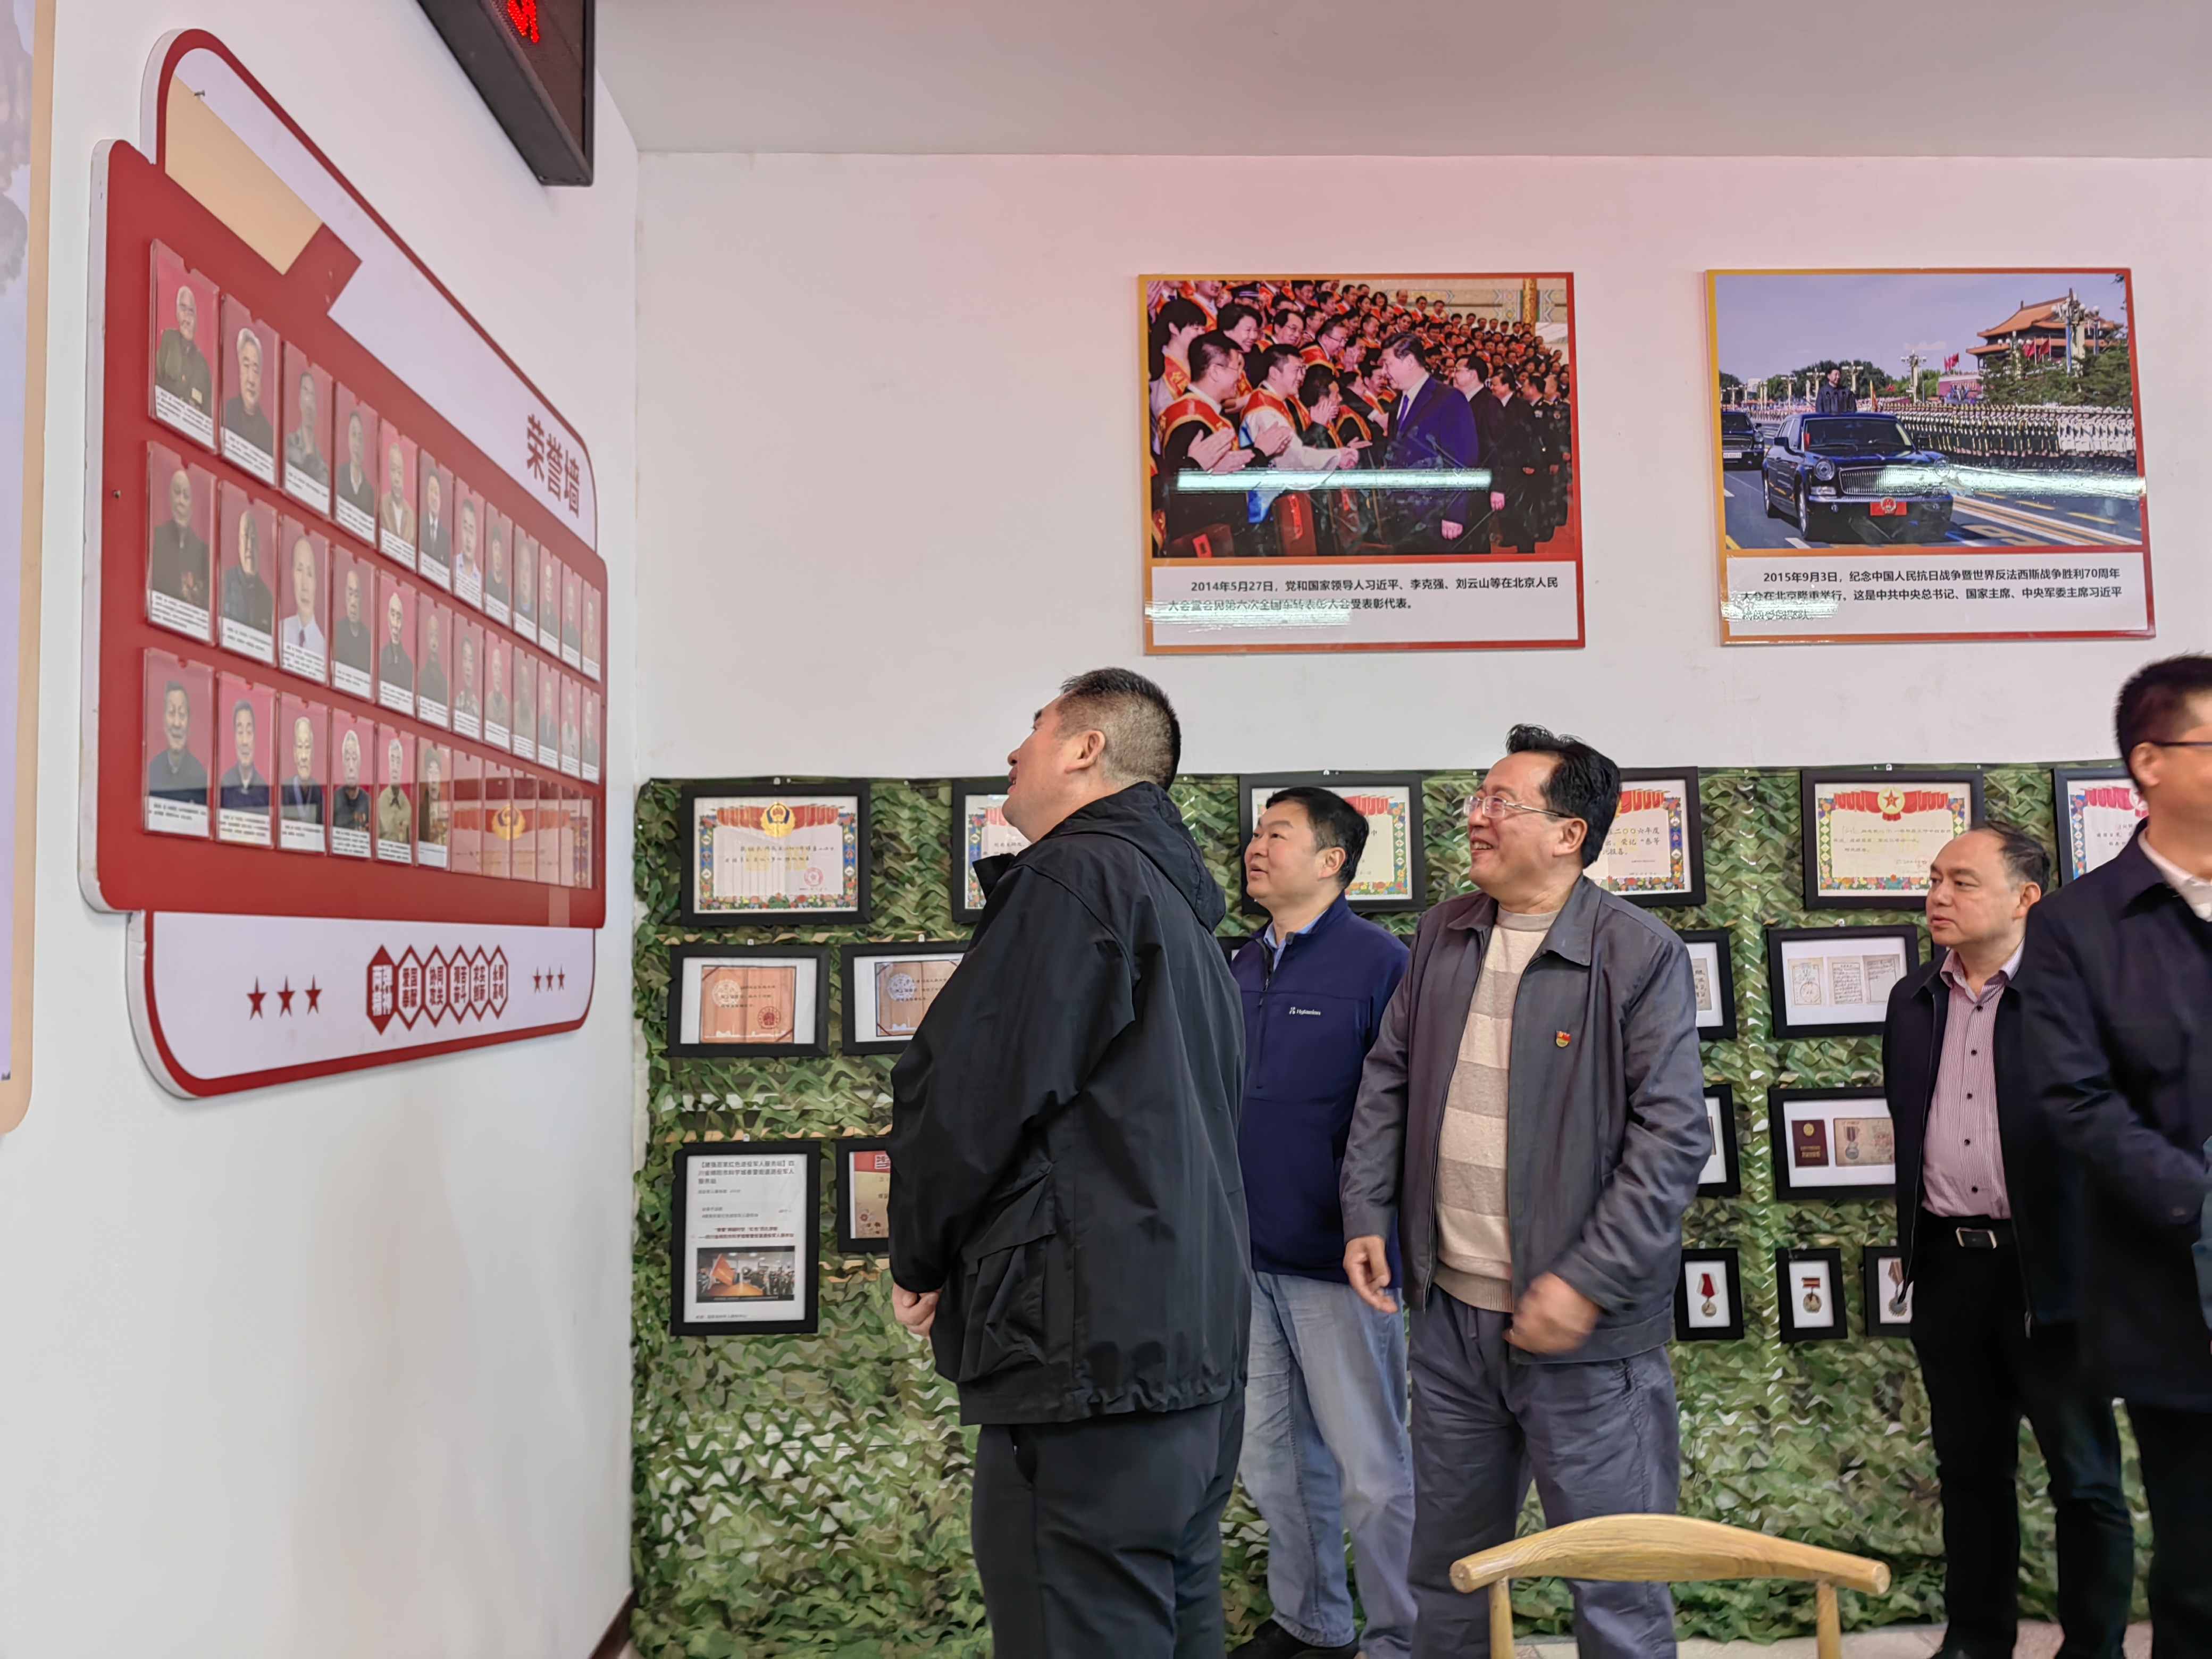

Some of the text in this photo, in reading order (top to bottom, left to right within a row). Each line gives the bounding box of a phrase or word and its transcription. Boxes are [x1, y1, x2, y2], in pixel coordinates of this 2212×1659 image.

[526, 414, 580, 519] 荣誉墙
[1763, 567, 2121, 583] 2015年9月3日，纪念中国人民抗日战争暨世界反法西斯战争胜利70周年
[1191, 577, 1558, 592] 2014年5月27日，党和国家领导人习近平、李克强、刘云山等在北京人民
